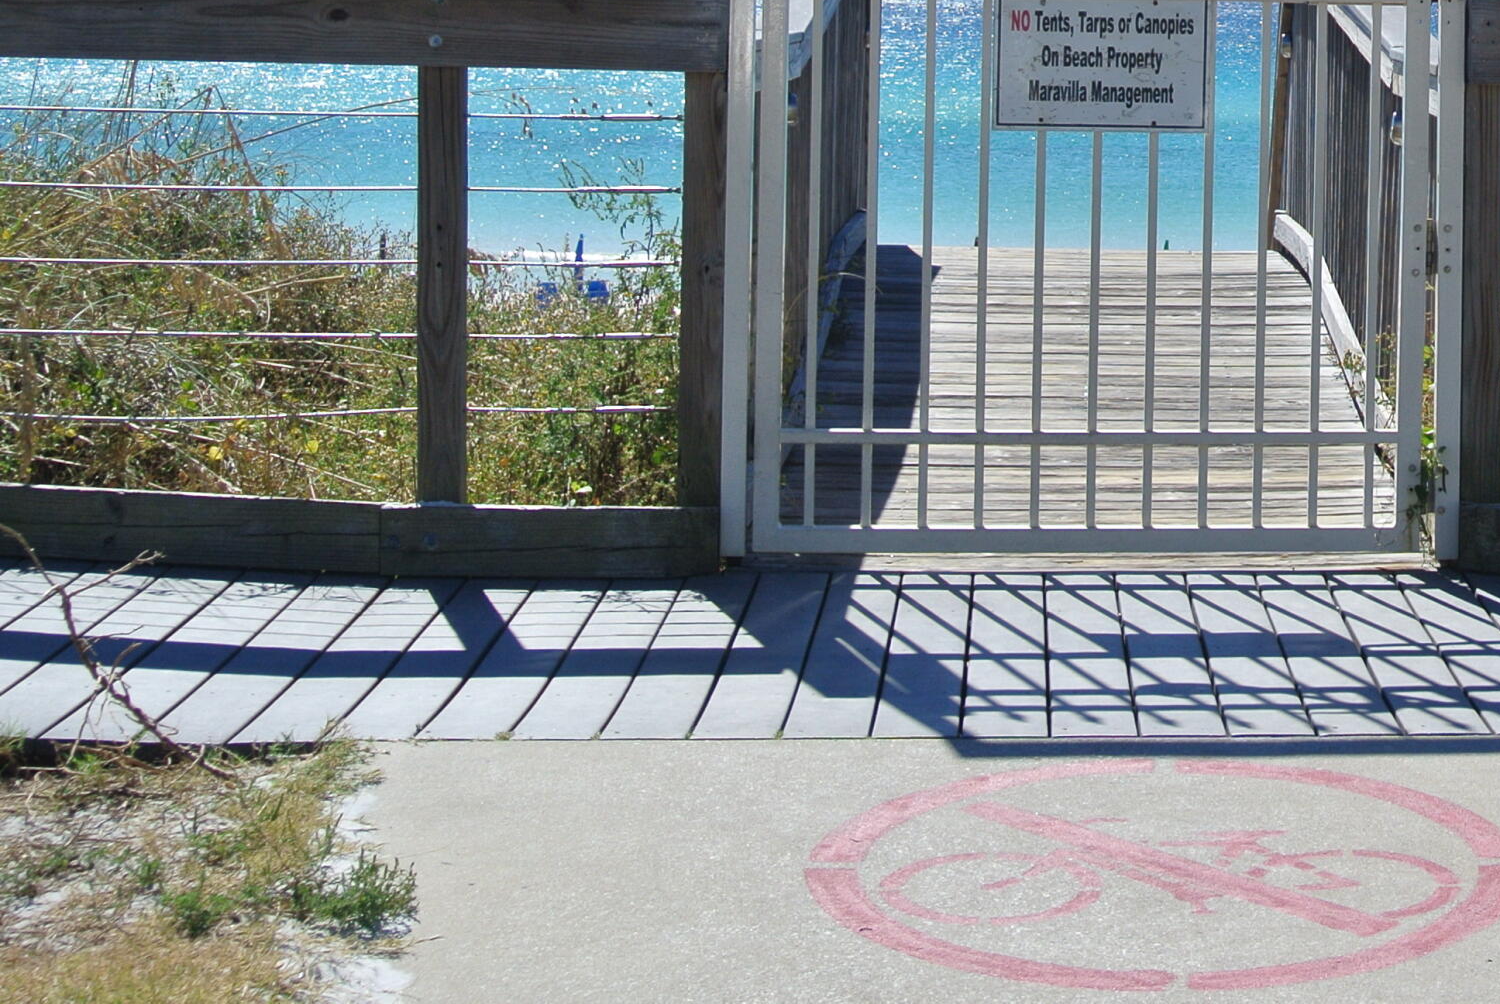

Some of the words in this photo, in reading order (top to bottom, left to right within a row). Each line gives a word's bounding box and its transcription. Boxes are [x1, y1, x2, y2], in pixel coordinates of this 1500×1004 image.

[1011, 9, 1031, 32] NO
[1035, 10, 1074, 37] Tents,
[1079, 11, 1114, 38] Tarps
[1118, 16, 1132, 34] or
[1135, 12, 1194, 40] Canopies
[1041, 45, 1059, 67] On
[1063, 46, 1103, 68] Beach
[1107, 47, 1163, 74] Property
[1028, 79, 1087, 102] Maravilla
[1091, 81, 1174, 108] Management
